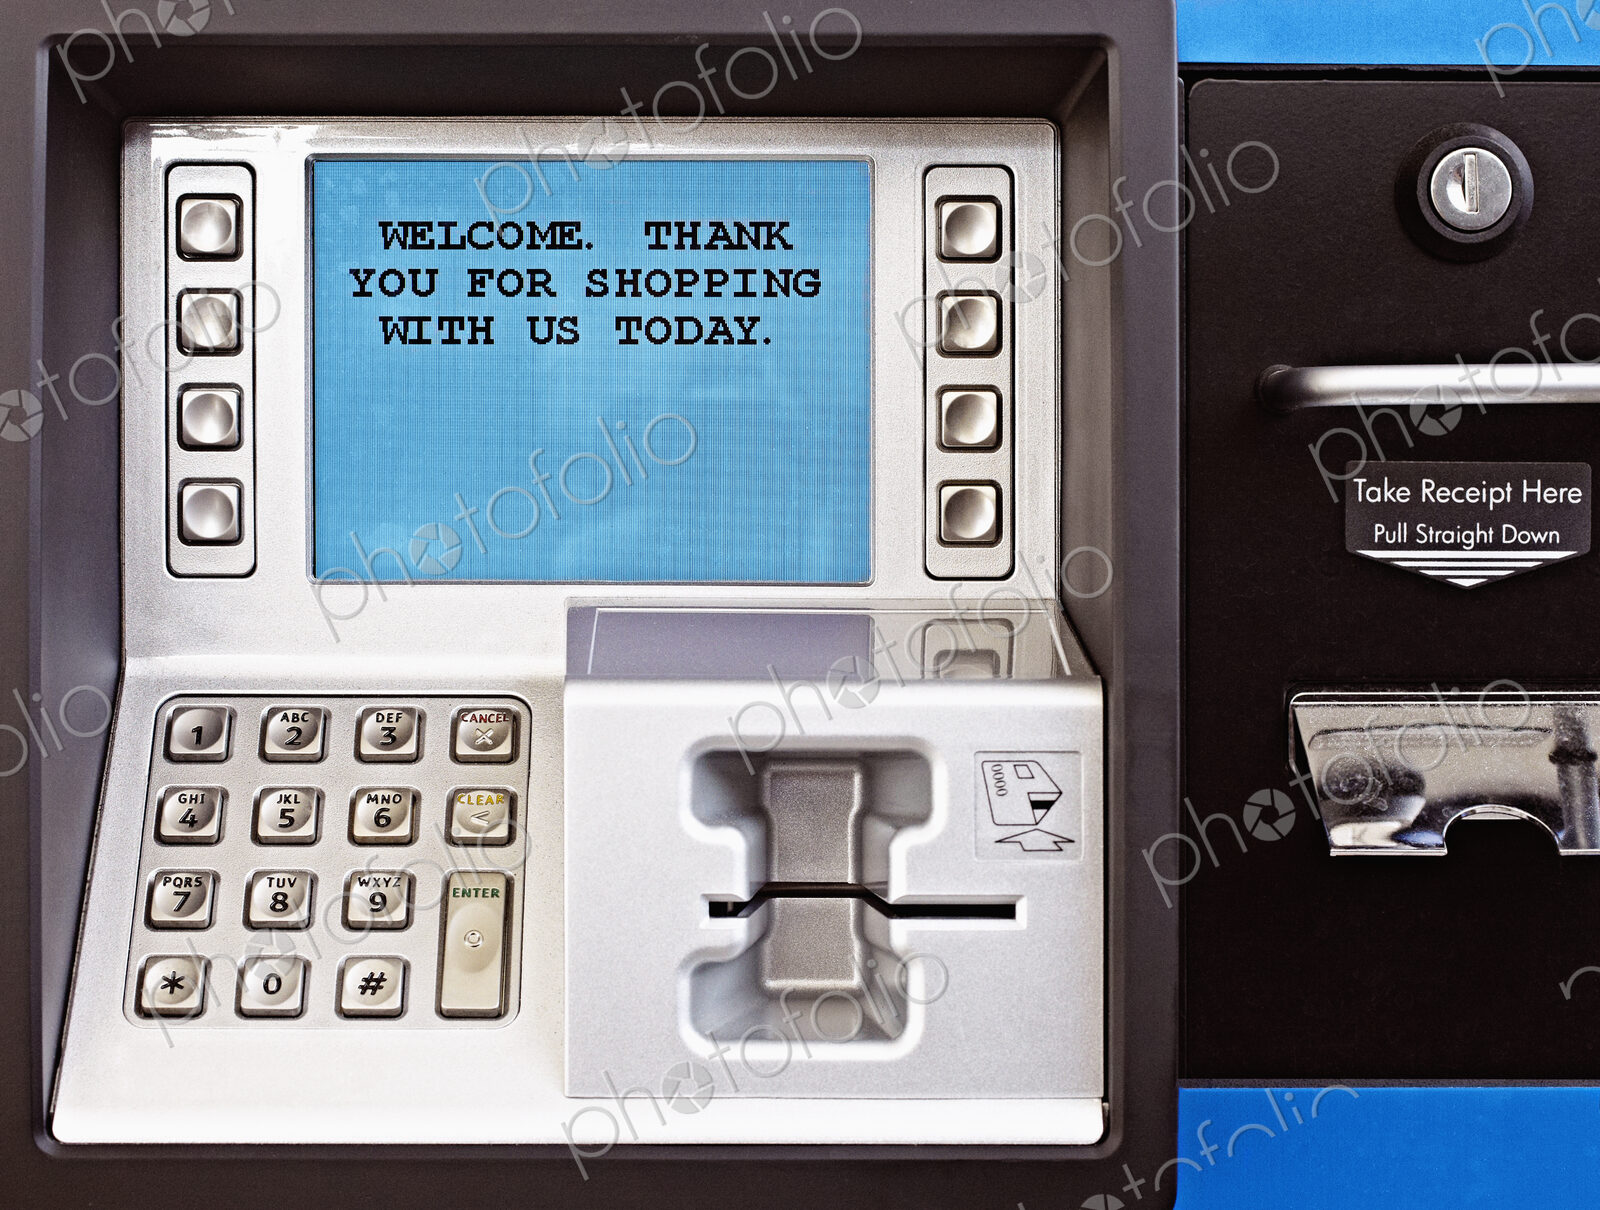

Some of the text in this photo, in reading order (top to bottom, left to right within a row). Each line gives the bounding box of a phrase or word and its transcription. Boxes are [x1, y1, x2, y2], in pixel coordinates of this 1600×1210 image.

[380, 221, 794, 250] WELCOME. THANK
[349, 268, 822, 298] YOU FOR SHOPPING
[379, 316, 771, 345] WITH US TODAY.
[1353, 476, 1583, 511] Take Receipt Here
[1374, 522, 1560, 550] Pull Straight Down
[280, 712, 310, 723] ABC
[375, 712, 403, 723] DEF
[461, 712, 510, 723] CANCEL
[191, 725, 204, 745] 1
[284, 726, 303, 746] 2
[379, 726, 397, 746] 3
[177, 793, 206, 804] GHI
[276, 793, 301, 805] JKL
[366, 793, 403, 804] MNO
[457, 793, 505, 806] CLEAR
[178, 808, 199, 829] 4
[278, 808, 296, 829] 5
[373, 807, 392, 828] 6
[162, 876, 203, 888] PQRS
[267, 876, 297, 888] TUV
[357, 876, 402, 888] WXYZ
[172, 891, 191, 912] 7
[269, 891, 289, 913] 8
[368, 891, 388, 913] 9
[452, 887, 500, 899] ENTER
